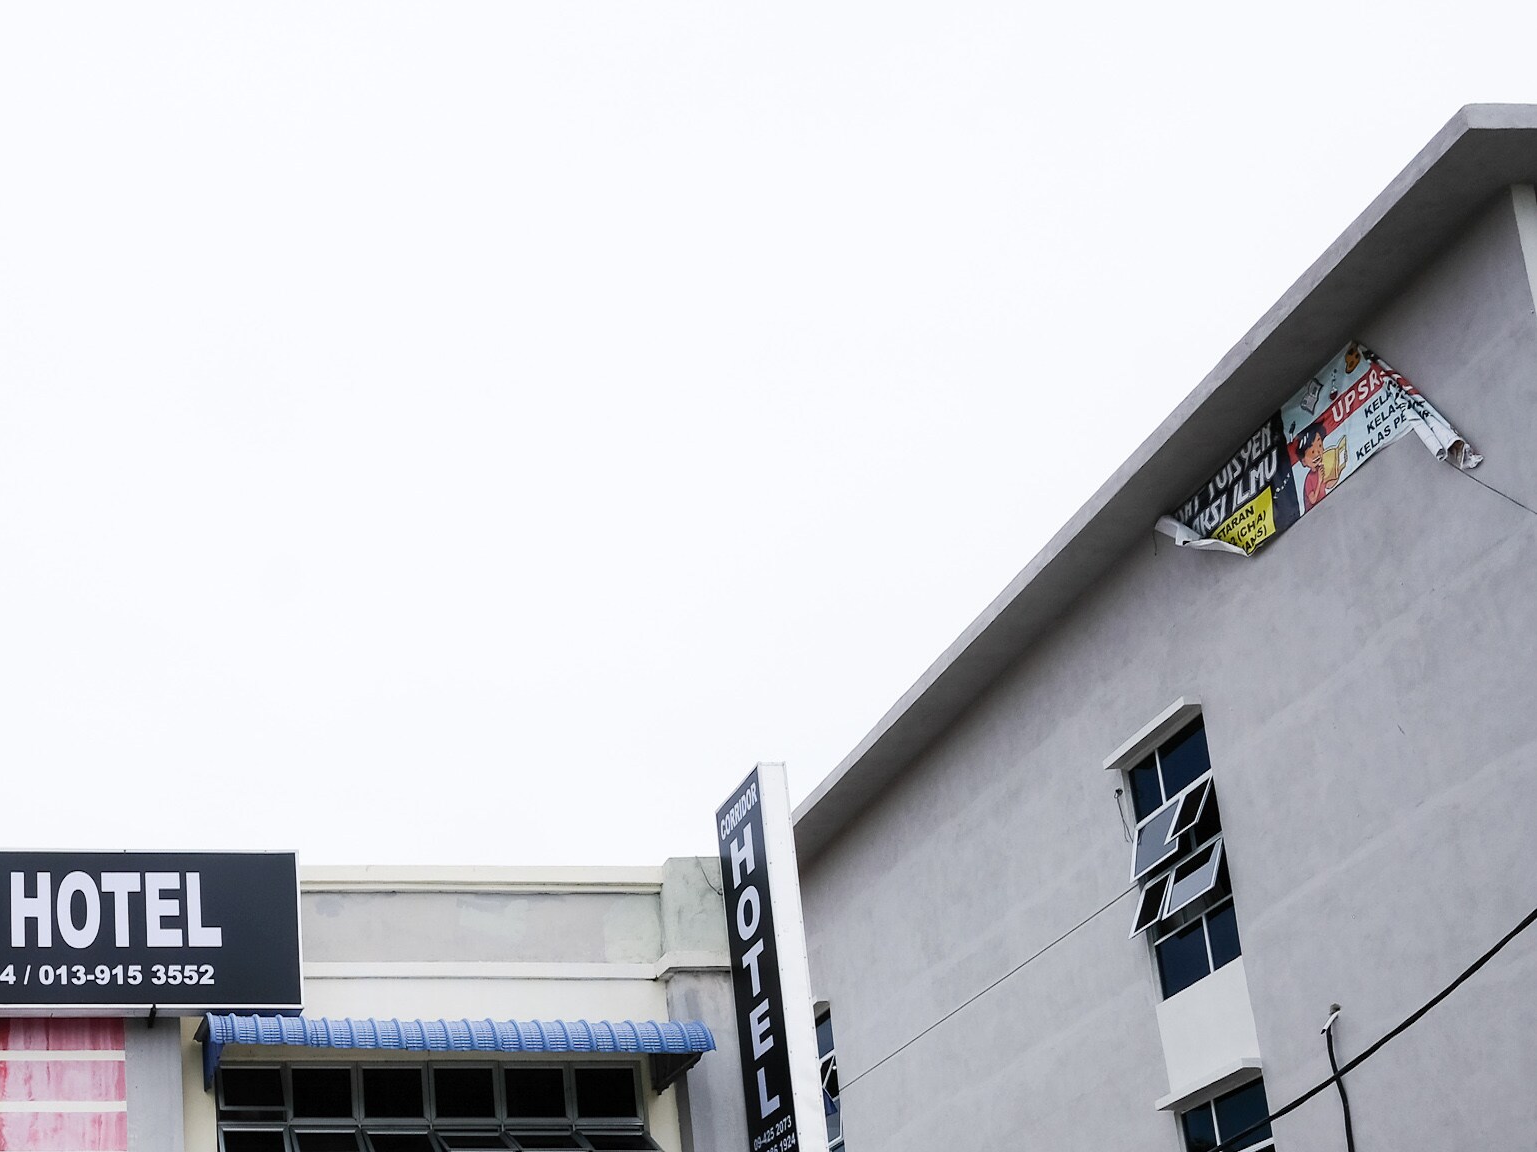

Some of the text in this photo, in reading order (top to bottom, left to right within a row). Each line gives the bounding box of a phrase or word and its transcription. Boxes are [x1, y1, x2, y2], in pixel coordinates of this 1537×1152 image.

[1364, 391, 1395, 418] KELA
[1356, 428, 1391, 461] KELAS
[1232, 447, 1277, 514] ILMU
[720, 782, 758, 841] CORRIDOR
[10, 869, 223, 950] HOTEL
[24, 964, 31, 985] /
[38, 963, 143, 986] 013-915
[151, 963, 215, 986] 3552
[730, 822, 780, 1119] HOTEL
[754, 1115, 792, 1151] 09-425 2073
[780, 1132, 796, 1152] 1924
